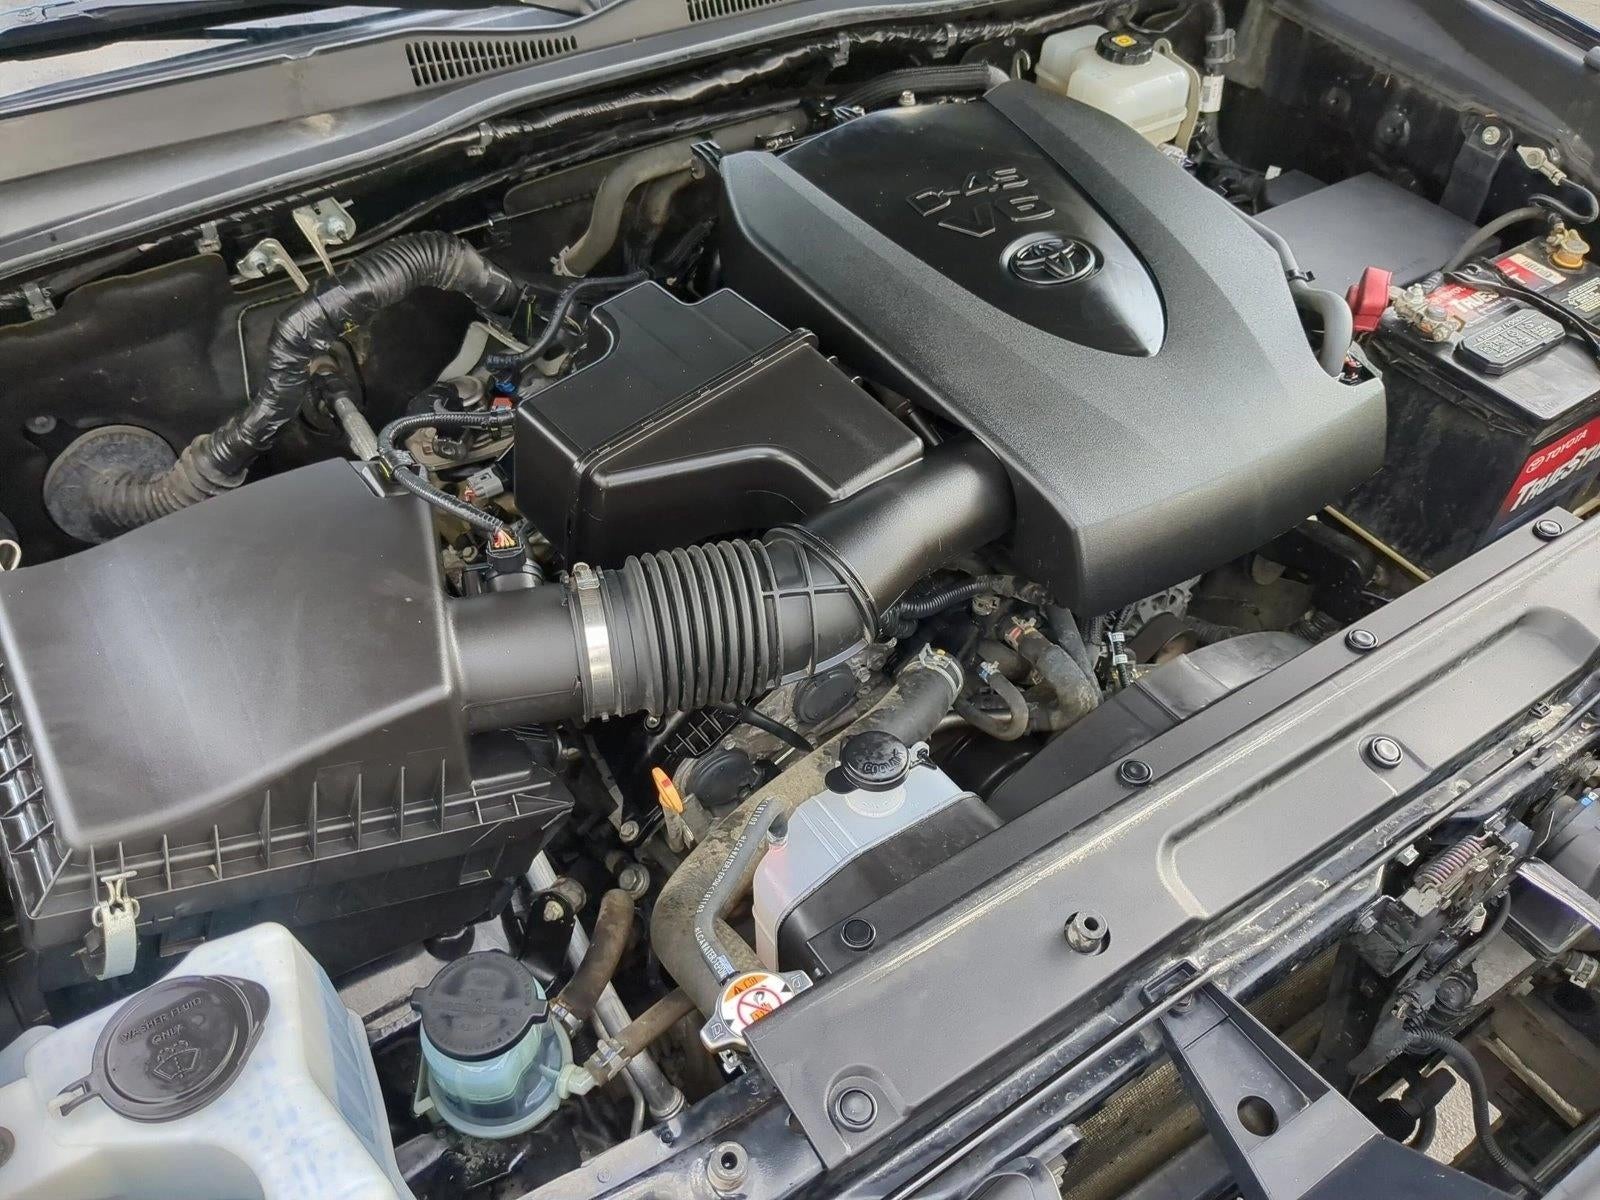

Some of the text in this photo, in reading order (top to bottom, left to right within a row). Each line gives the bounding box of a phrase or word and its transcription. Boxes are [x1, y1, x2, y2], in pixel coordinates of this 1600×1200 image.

[1545, 429, 1588, 462] TOYOTA
[119, 996, 202, 1044] WASHER FLUID
[152, 1024, 184, 1045] ONLY
